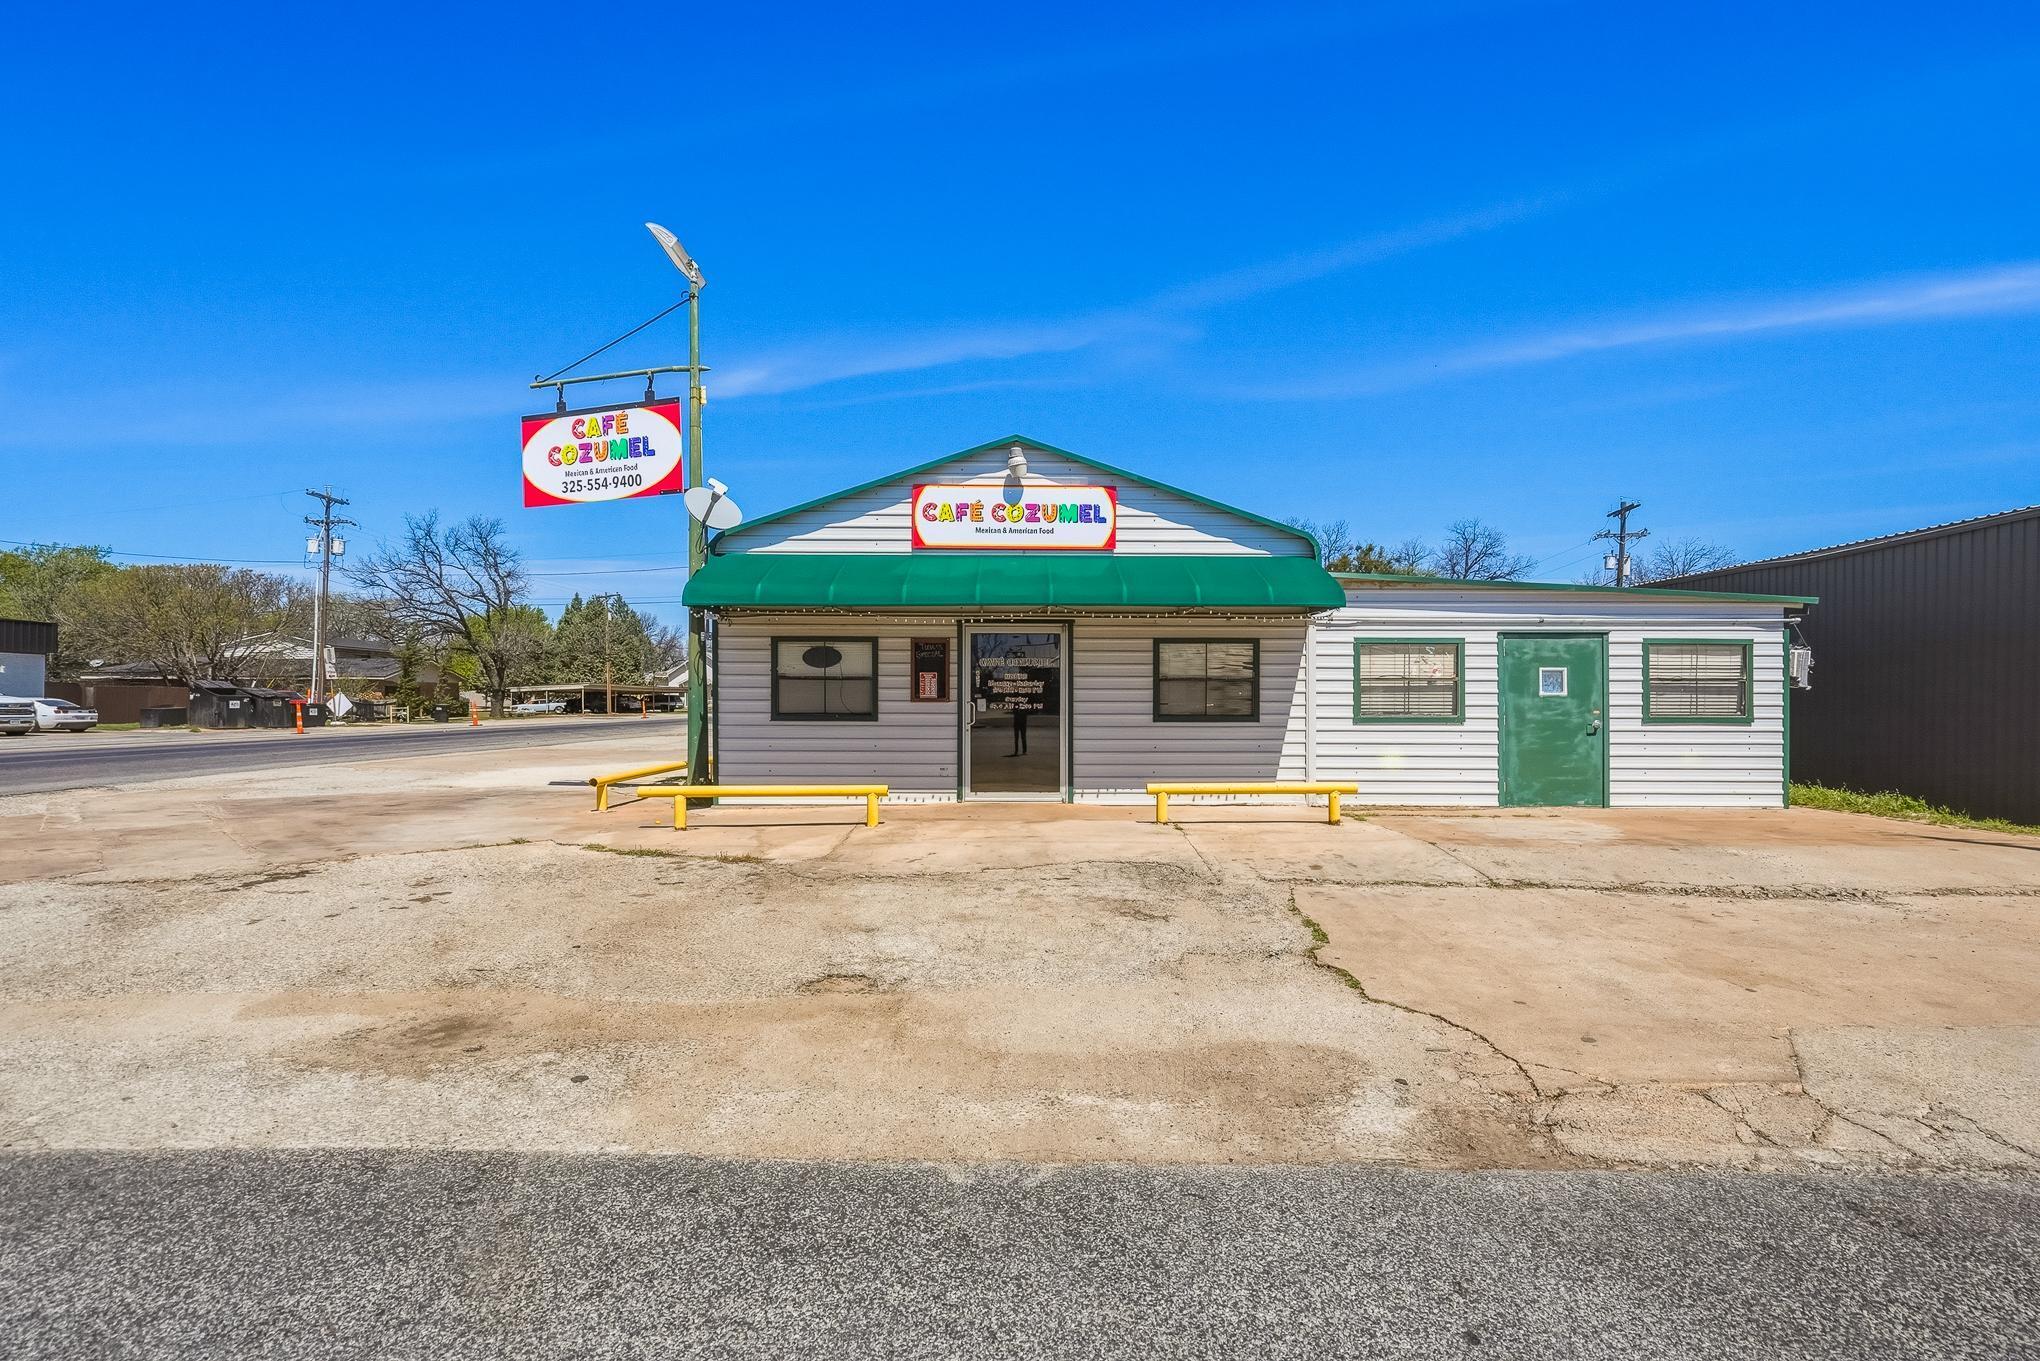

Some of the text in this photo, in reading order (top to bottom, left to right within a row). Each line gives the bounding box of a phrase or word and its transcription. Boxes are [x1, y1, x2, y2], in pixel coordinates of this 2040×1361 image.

[572, 411, 629, 439] CAFÉ
[548, 436, 656, 467] COZUMEL
[565, 463, 639, 478] Mexican & American Food
[562, 473, 642, 494] 325-554-9400
[922, 500, 1107, 523] CAFÉ COZUMEL
[975, 527, 1001, 535] Mexican
[1008, 527, 1038, 535] American
[1039, 527, 1055, 535] Food
